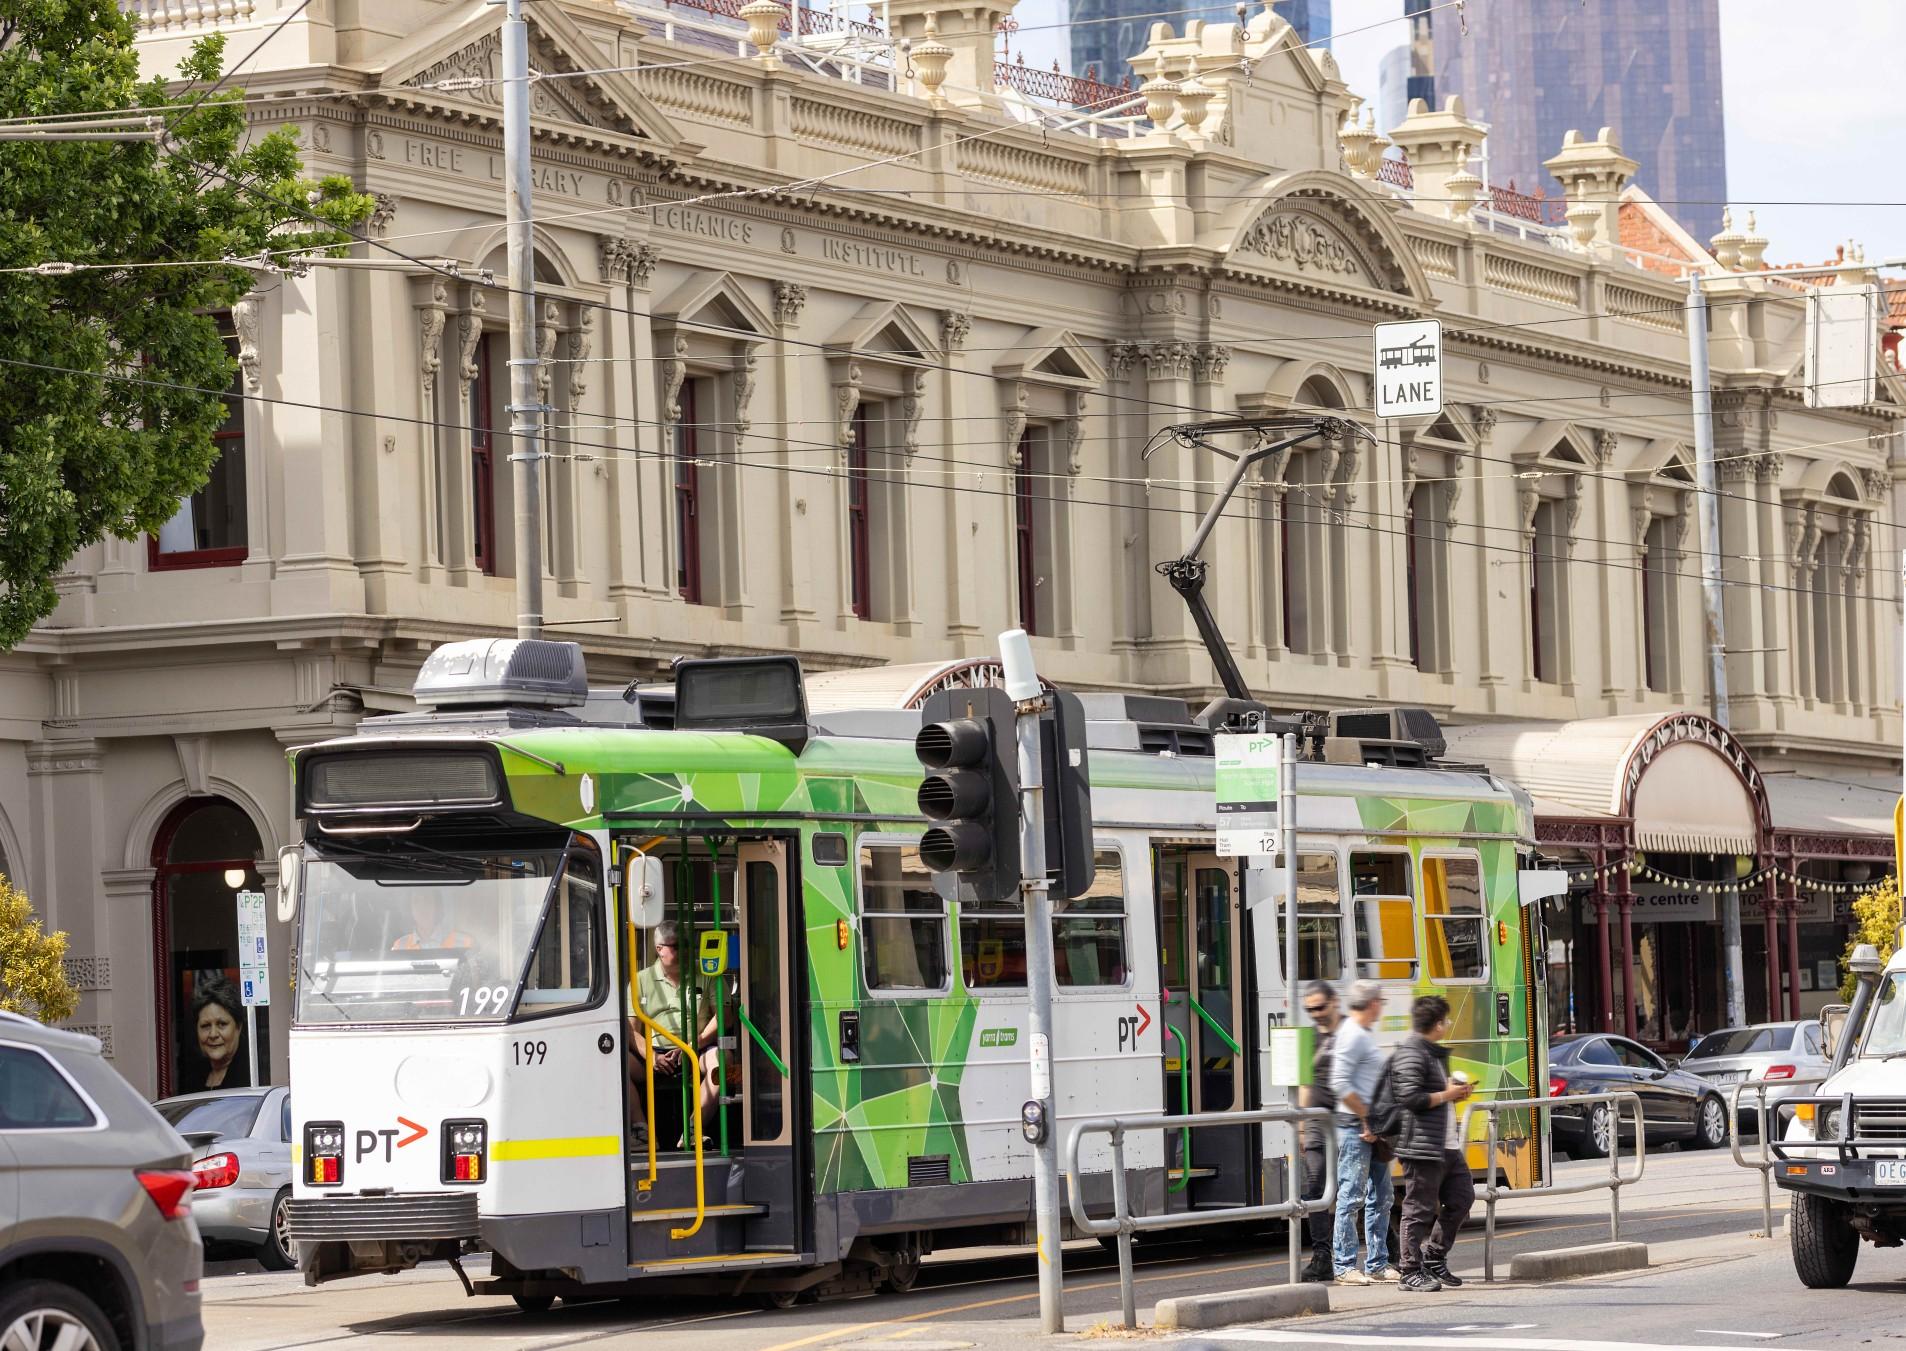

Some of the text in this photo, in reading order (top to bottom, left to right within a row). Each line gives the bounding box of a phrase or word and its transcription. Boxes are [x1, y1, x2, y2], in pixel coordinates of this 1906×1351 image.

[406, 139, 583, 197] FREE LRARY
[652, 205, 753, 244] ECHANICS
[1383, 381, 1434, 405] LANE
[1628, 716, 1757, 793] MUNICIPAL
[1258, 838, 1275, 852] 12
[253, 895, 264, 909] 2P
[1649, 892, 1700, 906] centre
[258, 970, 265, 984] P
[458, 985, 509, 1016] 199
[1118, 1016, 1139, 1053] PT
[512, 1040, 547, 1066] 199
[356, 1129, 400, 1164] PT
